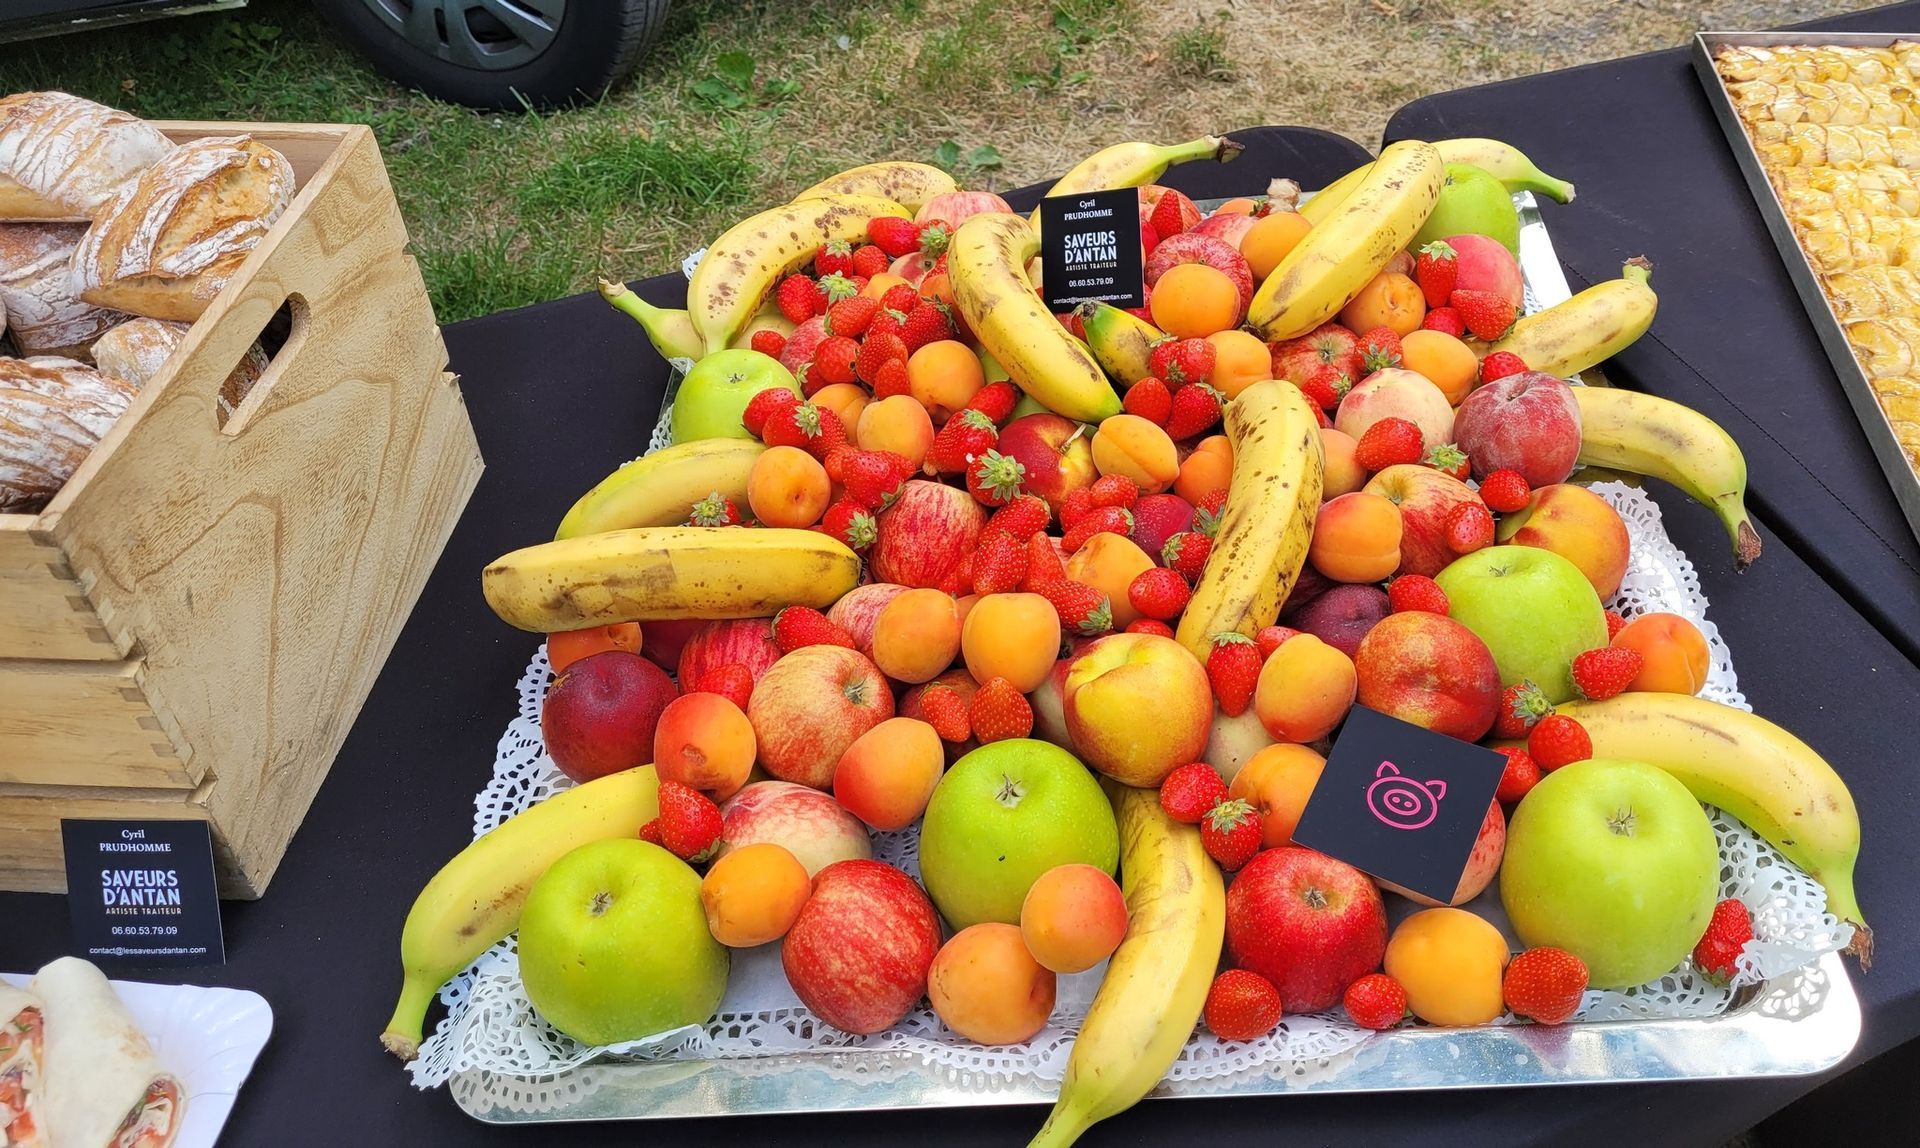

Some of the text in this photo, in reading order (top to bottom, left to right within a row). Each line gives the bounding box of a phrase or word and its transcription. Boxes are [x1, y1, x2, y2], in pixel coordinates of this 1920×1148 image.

[1080, 199, 1095, 209] Cyril
[1064, 209, 1113, 220] PRUDHOMME
[1064, 231, 1116, 249] SAVEURS
[1064, 246, 1117, 264] D'ANTAN
[1065, 261, 1117, 271] ARTISTE TRAITEUR
[1069, 277, 1114, 287] 06.60.53.79.09
[121, 829, 145, 840] Cyril
[99, 842, 172, 852] PRUDHOMME
[101, 869, 179, 887] SAVEURS
[103, 887, 181, 906] D'ANTAN
[105, 907, 182, 915] ARTISTE TRAITEUR
[111, 926, 178, 935] 06.60.53.79.09
[89, 946, 207, 956] contact@lessaveursdantan.com
